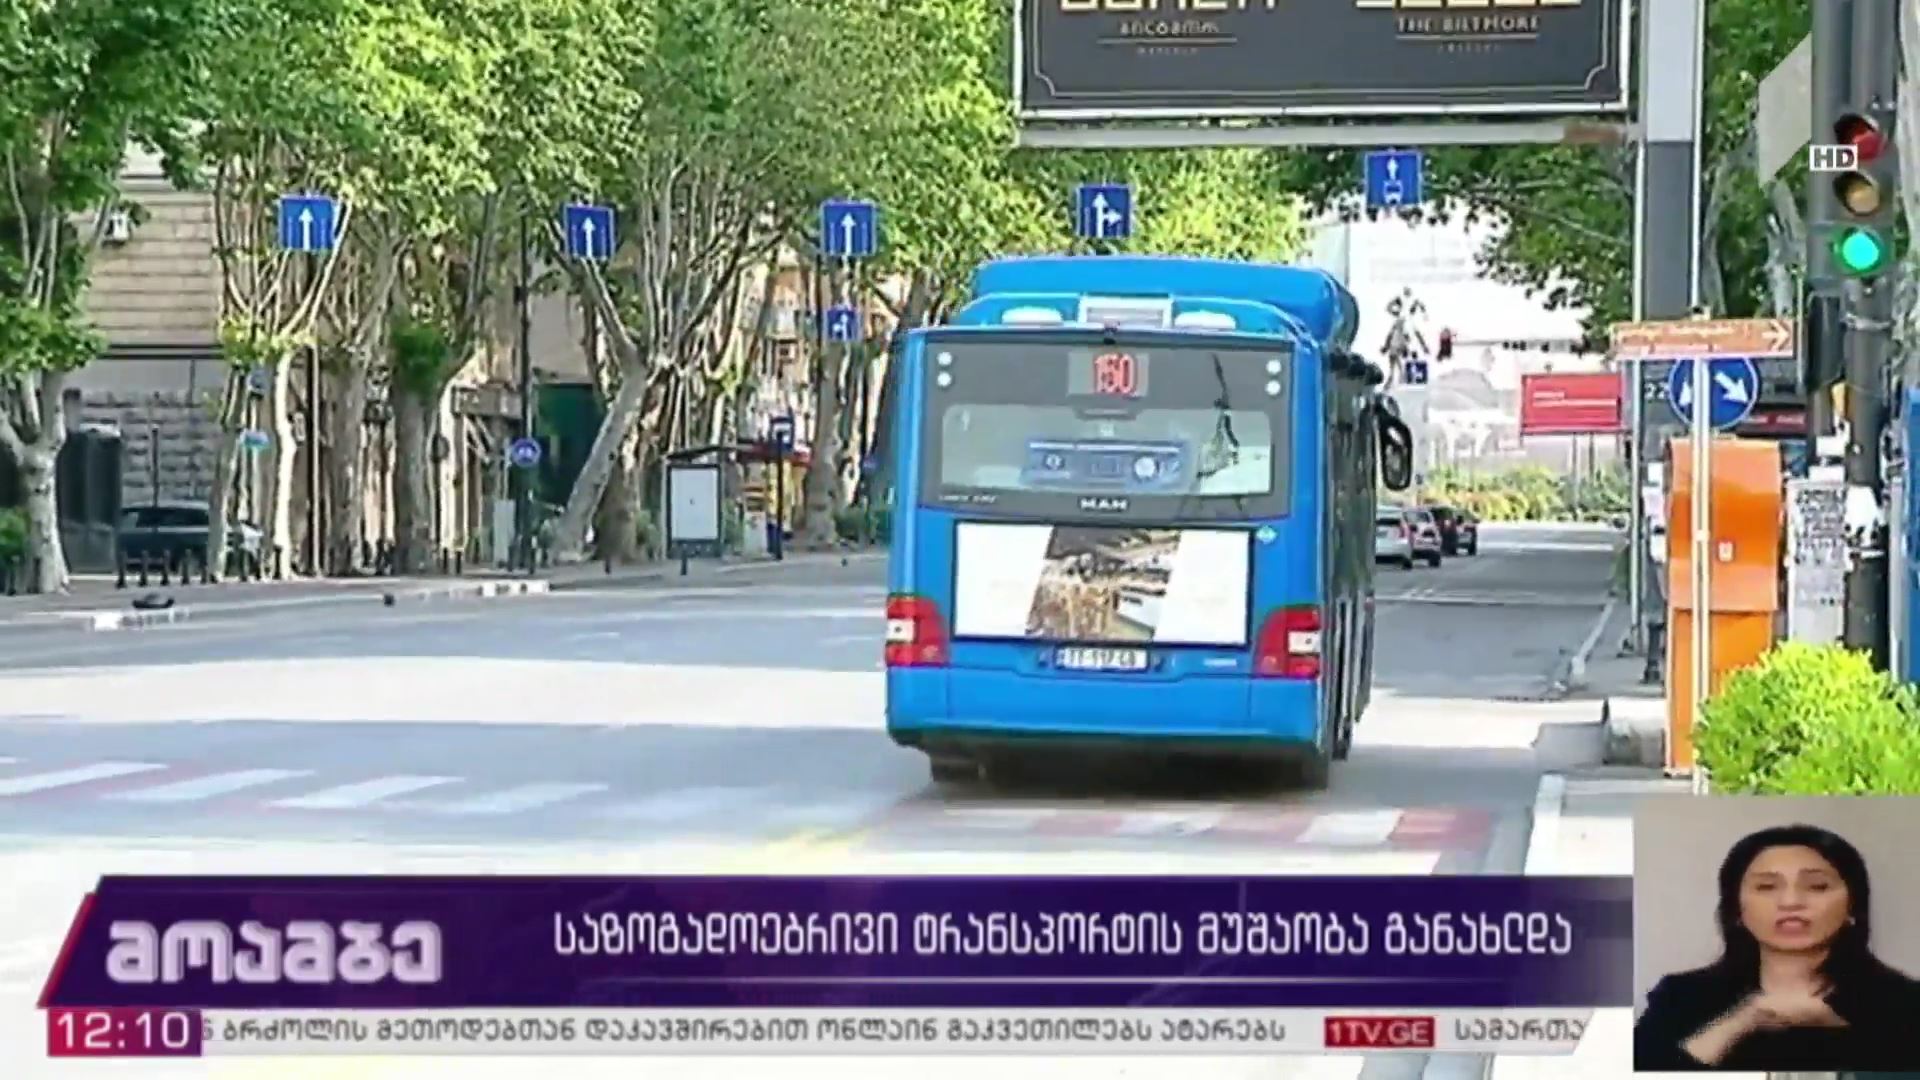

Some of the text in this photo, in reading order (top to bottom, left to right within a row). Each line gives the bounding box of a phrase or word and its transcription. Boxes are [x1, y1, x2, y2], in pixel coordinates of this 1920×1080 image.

[1398, 15, 1539, 32] THE BILTMORE
[1094, 353, 1135, 394] 150
[1080, 498, 1127, 510] MAN
